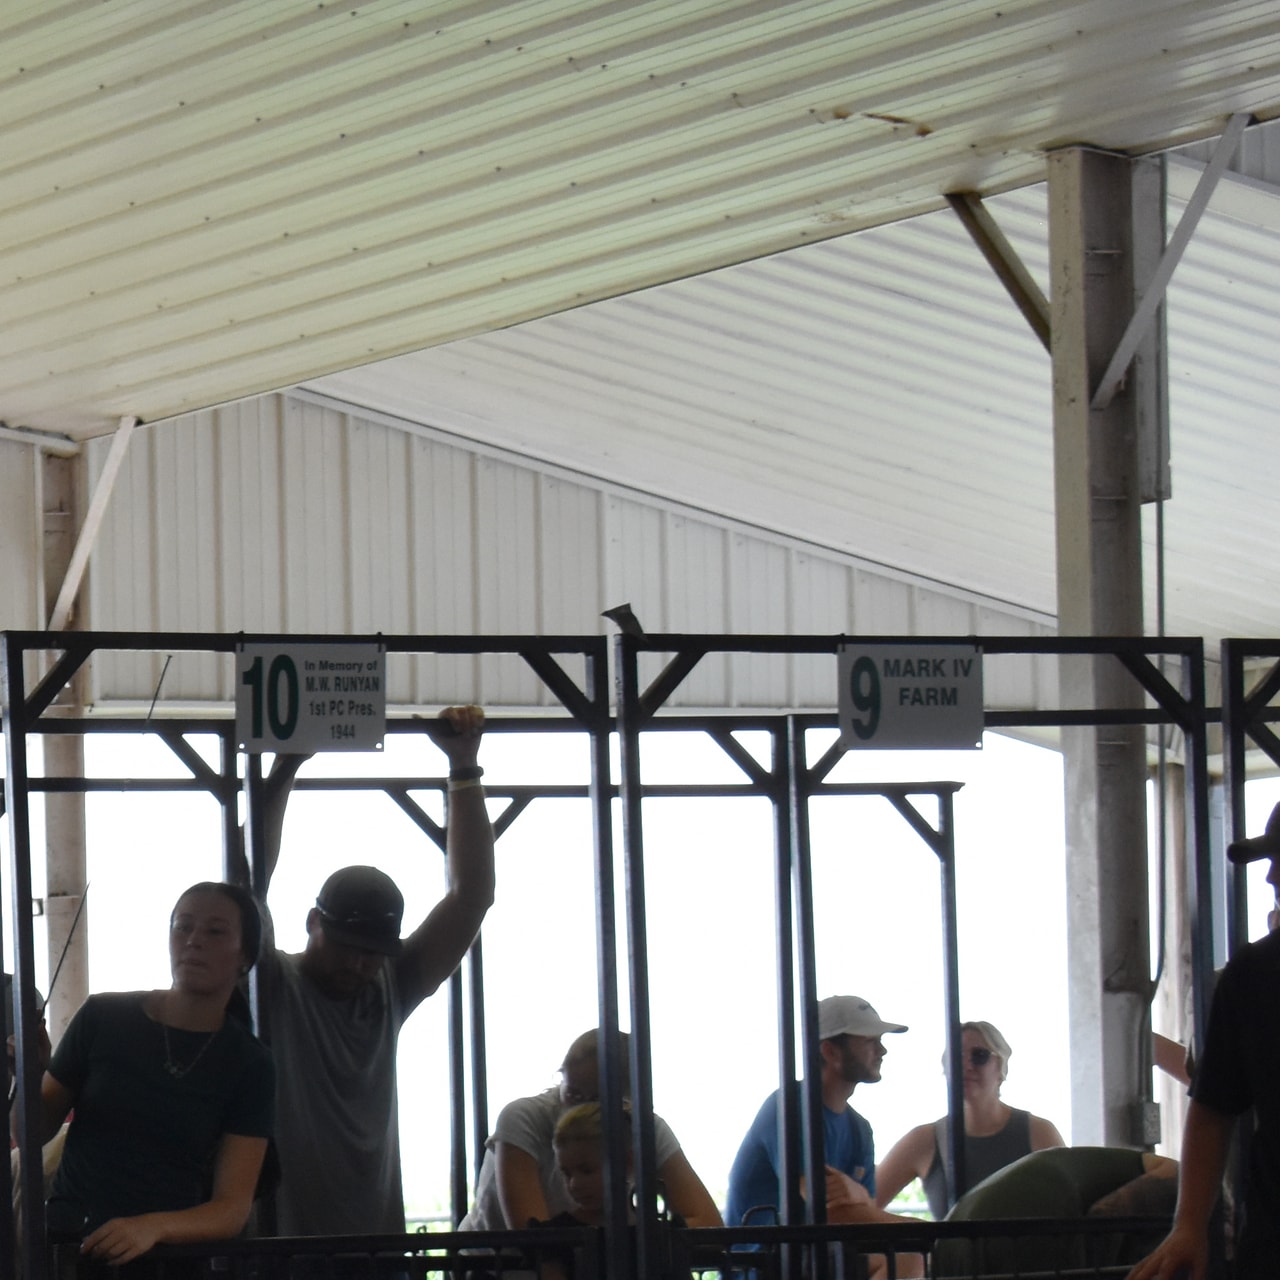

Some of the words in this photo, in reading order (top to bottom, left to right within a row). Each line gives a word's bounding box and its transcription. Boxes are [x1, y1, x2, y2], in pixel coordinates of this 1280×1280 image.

[305, 660, 315, 670] In
[319, 661, 363, 672] Memory
[367, 661, 377, 671] of
[884, 659, 945, 677] MARK
[954, 660, 973, 677] IV
[334, 677, 379, 692] RUNYAN
[243, 654, 299, 740] 10
[851, 656, 881, 740] 9
[899, 688, 957, 706] FARM
[309, 701, 326, 716] 1st
[330, 701, 344, 716] PC
[348, 701, 376, 716] Pres.
[331, 725, 355, 739] 1944
